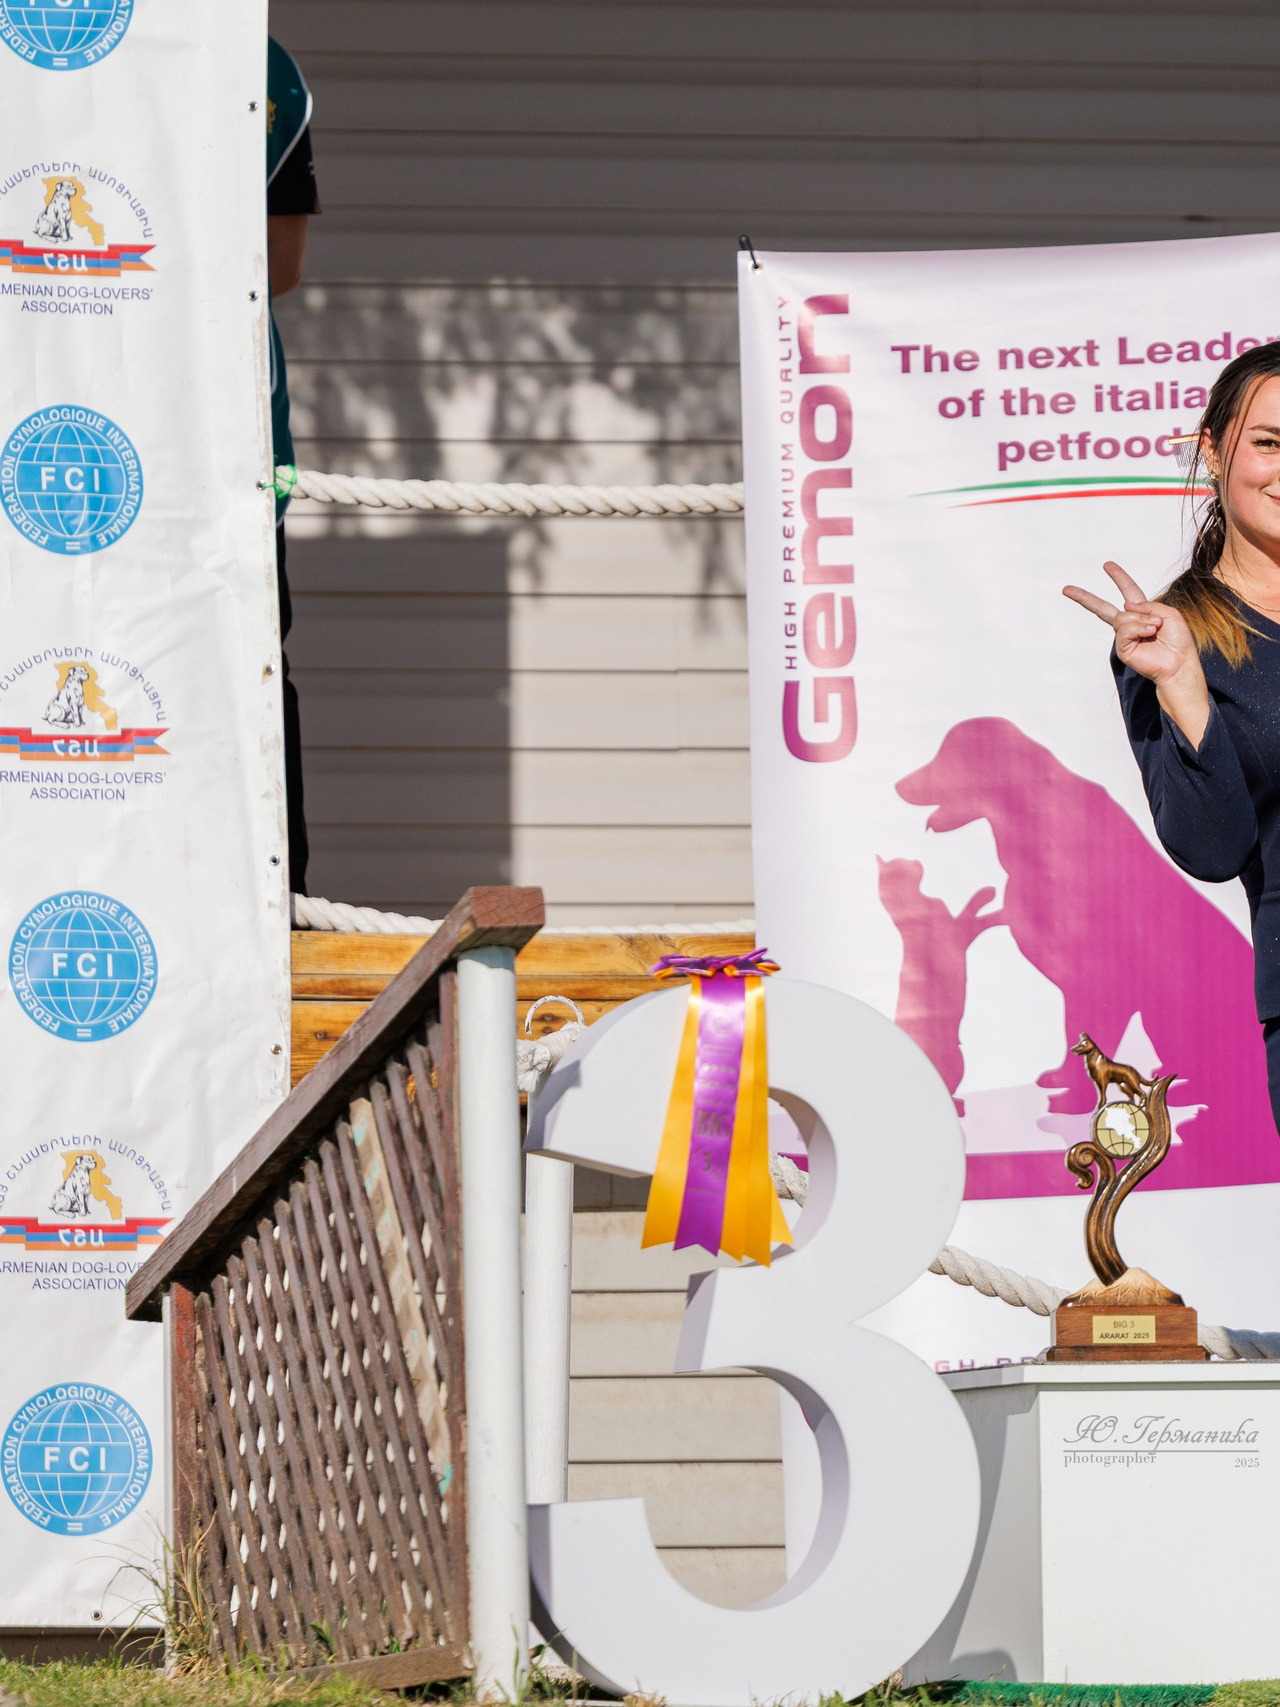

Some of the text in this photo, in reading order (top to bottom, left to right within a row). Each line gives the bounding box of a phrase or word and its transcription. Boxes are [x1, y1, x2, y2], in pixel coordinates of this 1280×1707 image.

[0, 162, 81, 195] ՆԱՍԵՐՆԵՐԻ
[0, 283, 53, 297] MENIAN
[21, 300, 113, 315] ASSOCIATION
[891, 344, 980, 374] The
[999, 339, 1100, 371] next
[938, 387, 984, 419] of
[1000, 385, 1076, 416] the
[998, 427, 1183, 471] petfood
[2, 408, 141, 546] FEDERATION CYNOLOGIQUE INTERNATIONALE
[41, 467, 99, 492] FCI
[778, 296, 797, 670] HIGH PREMIUM QUALITY
[782, 293, 857, 763] Gemon
[30, 787, 125, 800] ASSOCIATION
[12, 894, 154, 1033] FEDERATION CYNOLOGIQUE INTERNATIONALE
[52, 952, 113, 977] FCI
[696, 1109, 730, 1139] BIG
[701, 1153, 712, 1172] 3
[0, 1261, 67, 1273] RMENIAN
[32, 1278, 128, 1290] ASSOCIATION
[1099, 1332, 1150, 1340] ARARAT 2025
[1113, 1320, 1136, 1329] BIG 3
[527, 977, 981, 1704] 3
[4, 1385, 149, 1527] FEDERATION CYNOLOGIQUE INTERNATIONALE
[44, 1446, 106, 1472] FCI
